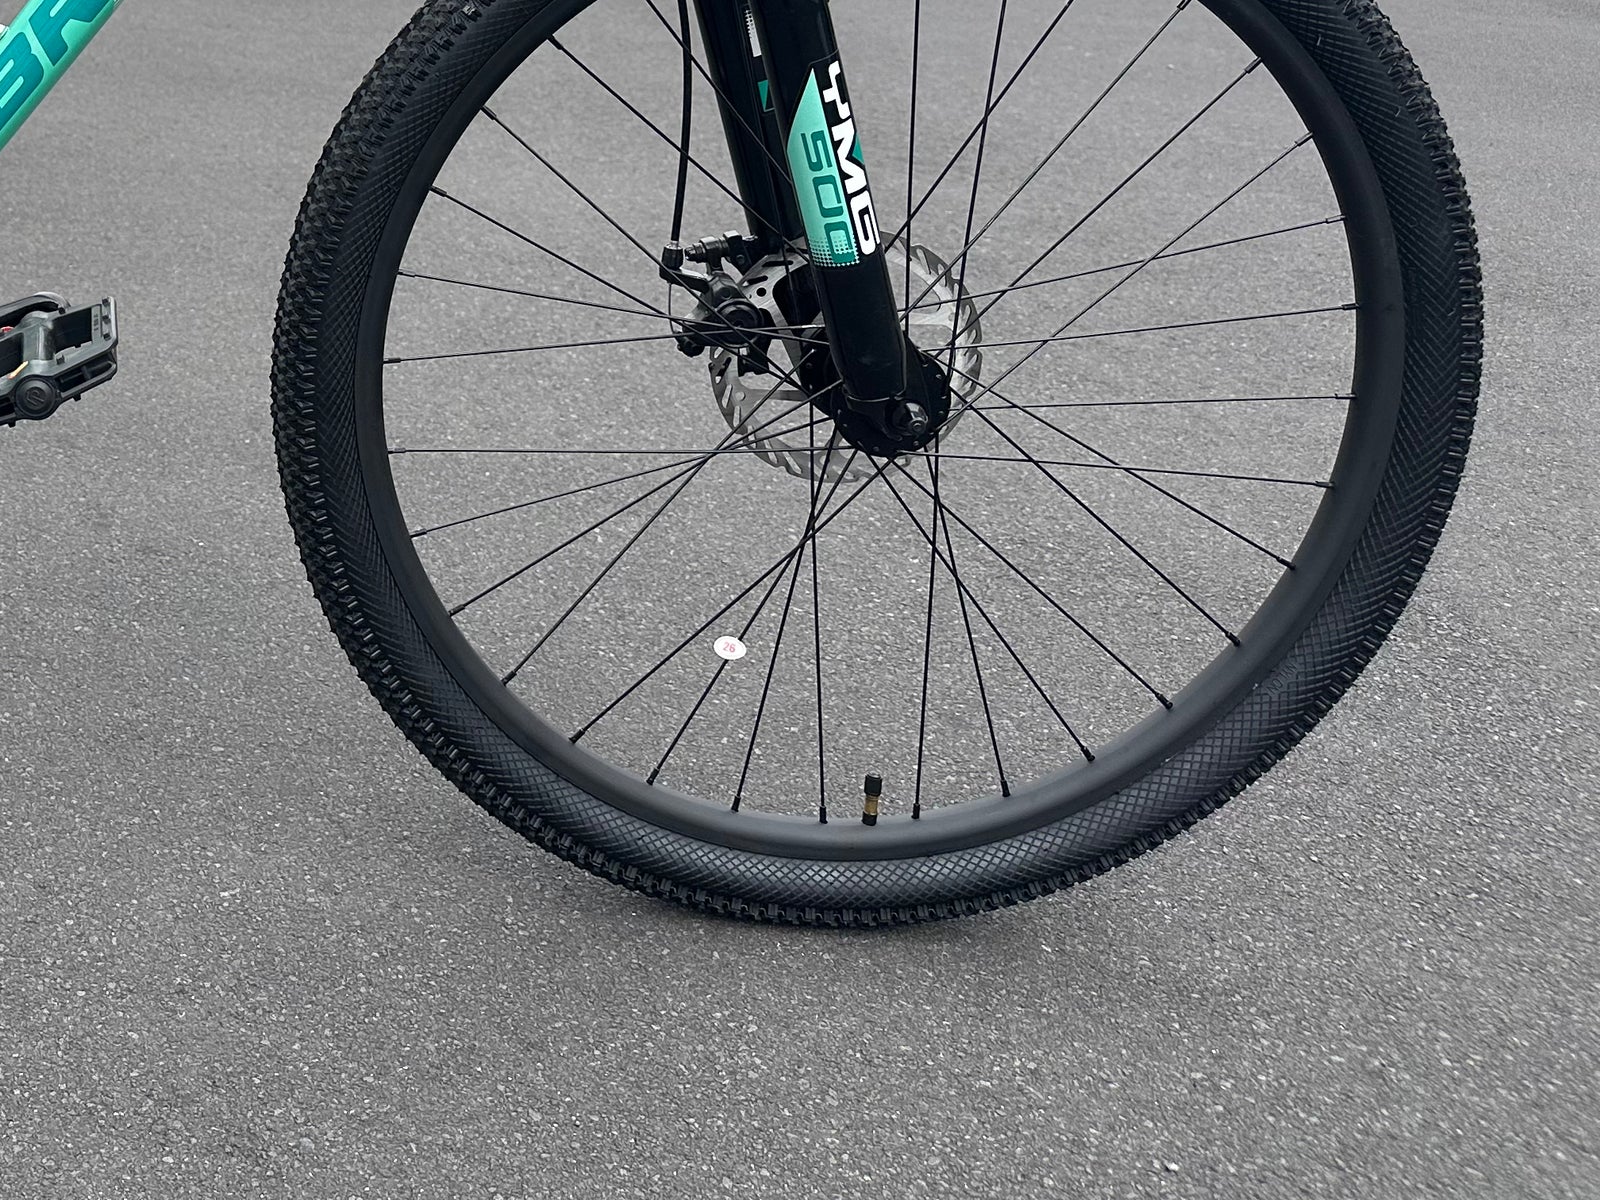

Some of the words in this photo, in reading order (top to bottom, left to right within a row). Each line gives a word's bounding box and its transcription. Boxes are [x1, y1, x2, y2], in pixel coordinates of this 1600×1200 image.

[800, 129, 857, 264] 500
[822, 60, 881, 256] YMG
[722, 641, 736, 653] 26
